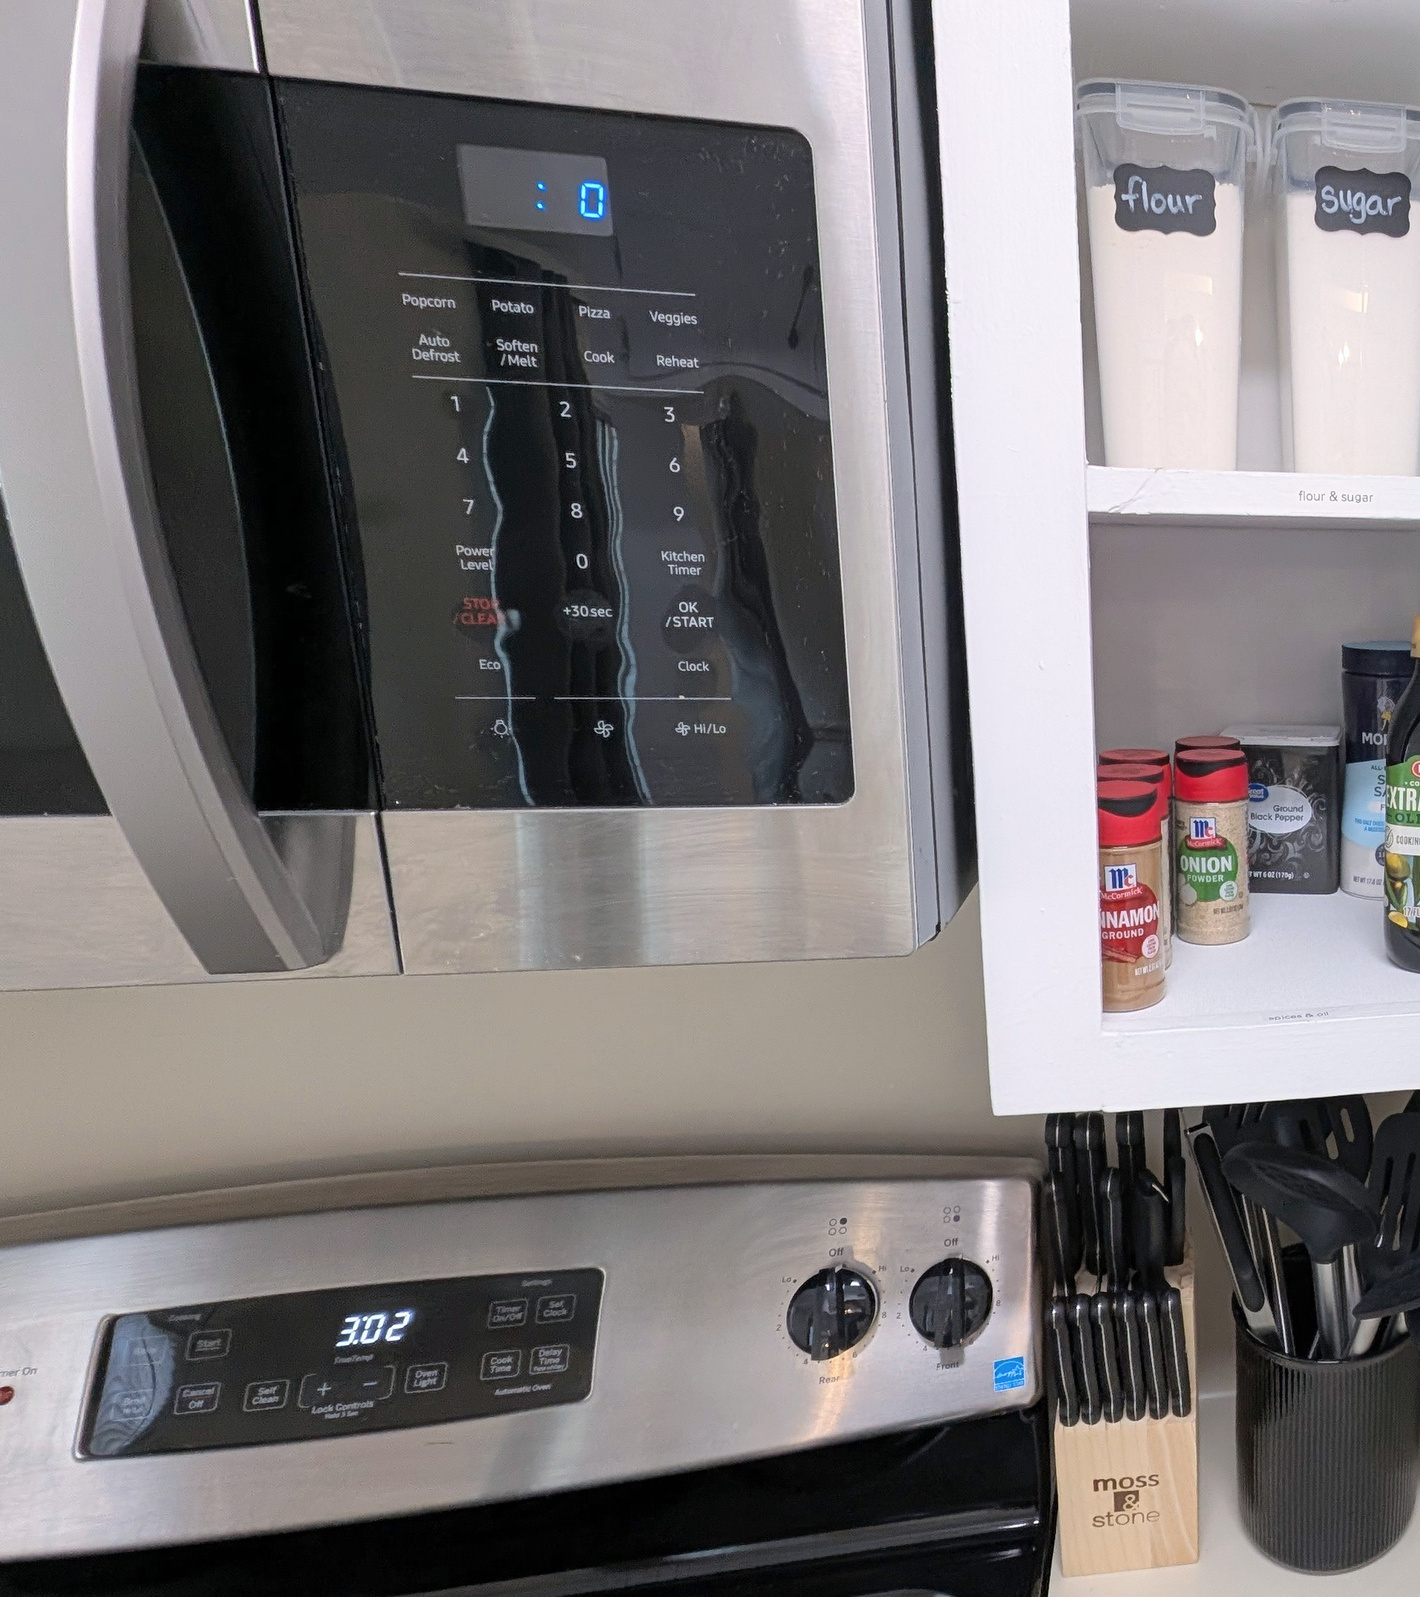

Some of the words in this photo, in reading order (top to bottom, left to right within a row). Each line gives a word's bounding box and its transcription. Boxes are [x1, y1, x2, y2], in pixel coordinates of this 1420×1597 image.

[1121, 175, 1203, 215] flour
[1321, 185, 1402, 224] sugar
[401, 293, 457, 310] Popcorn
[491, 300, 535, 315] Potato
[578, 306, 611, 320] Pizza
[649, 310, 698, 327] Veggies
[418, 334, 451, 348] Auto
[496, 339, 538, 354] Soften
[411, 348, 461, 364] Defrost
[500, 353, 538, 368] /Melt
[583, 351, 615, 364] Cook
[656, 355, 699, 370] Reheat
[450, 396, 460, 412] 1
[560, 402, 572, 419] 2
[663, 407, 676, 423] 3
[456, 448, 470, 464] 4
[565, 453, 577, 469] 5
[669, 458, 680, 473] 6
[1299, 490, 1325, 503] flour
[1329, 491, 1338, 503] &
[1341, 493, 1374, 506] sugar
[462, 500, 475, 515] 7
[571, 503, 583, 519] 8
[673, 506, 684, 522] 9
[455, 545, 495, 557] Power
[661, 550, 706, 564] Kitchen
[460, 559, 494, 571] Level
[576, 553, 588, 569] 0
[667, 564, 702, 577] Timer
[678, 602, 699, 613] OK
[665, 615, 714, 629] /START
[479, 659, 501, 670] Eco
[678, 660, 710, 673] Clock
[694, 722, 726, 735] Hi/Lo
[1275, 814, 1304, 822] Pepper
[1180, 855, 1233, 873] ONION
[1099, 887, 1143, 900] McCormick
[1102, 928, 1144, 940] GROUND
[944, 1238, 959, 1247] Off
[828, 1248, 844, 1258] Off
[496, 1305, 522, 1313] Timer
[549, 1300, 564, 1308] Set
[493, 1312, 523, 1322] On/Off
[543, 1308, 568, 1317] Clock
[335, 1311, 412, 1347] 3:02
[539, 1348, 563, 1357] Delay
[491, 1356, 514, 1365] Cook
[540, 1357, 560, 1365] Time
[936, 1361, 960, 1370] Front
[22, 1367, 38, 1375] On
[415, 1370, 438, 1378] Oven
[490, 1365, 512, 1374] Time
[413, 1377, 438, 1388] Light
[819, 1375, 840, 1384] Rear
[182, 1387, 215, 1398] Cancel
[257, 1385, 278, 1396] Self
[494, 1385, 531, 1396] Automatic
[532, 1383, 552, 1391] Oven
[188, 1399, 204, 1409] Off
[252, 1395, 280, 1405] Clean
[311, 1404, 334, 1415] Lock
[336, 1401, 374, 1412] Controls
[1093, 1474, 1160, 1492] moss
[1092, 1511, 1160, 1527] stone
